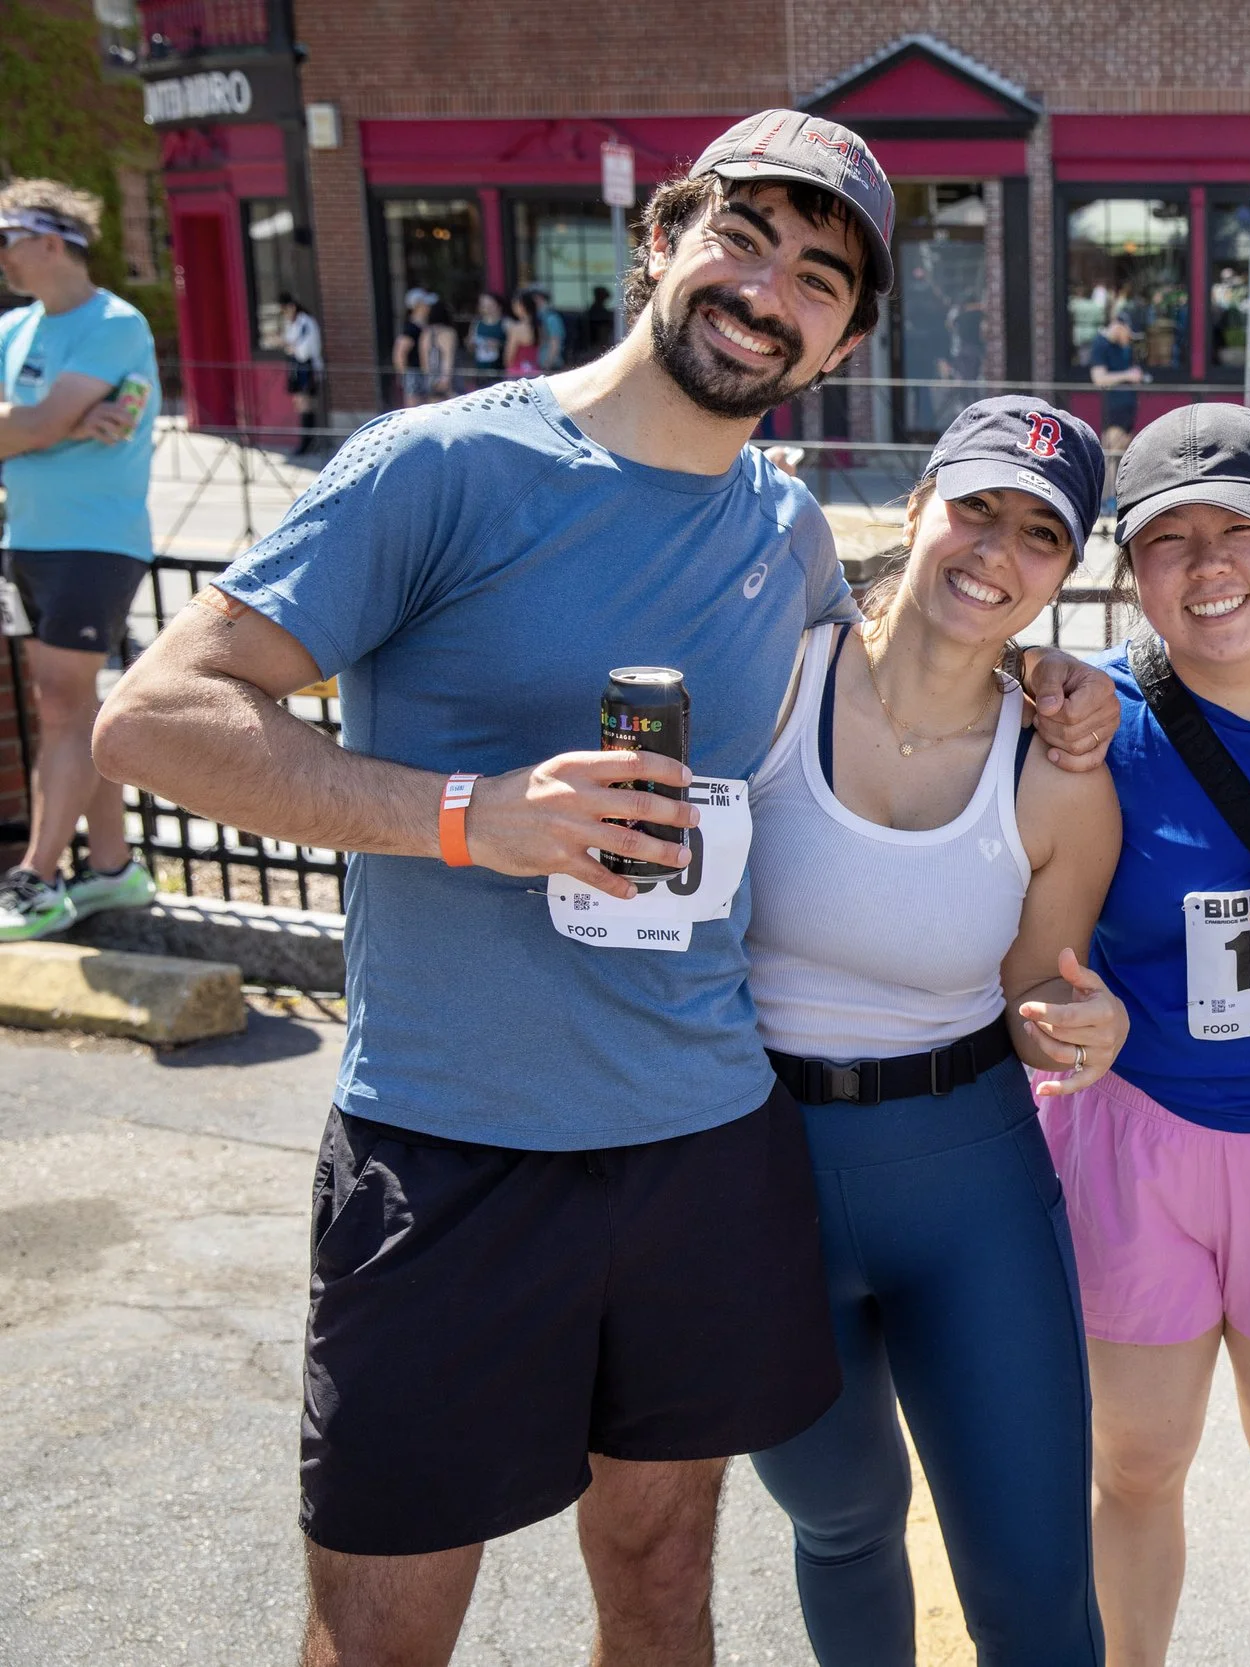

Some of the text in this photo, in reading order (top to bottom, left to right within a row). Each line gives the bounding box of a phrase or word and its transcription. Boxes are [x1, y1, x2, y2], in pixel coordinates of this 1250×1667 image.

[802, 130, 880, 191] MIT
[1017, 411, 1063, 458] B
[601, 708, 662, 732] ite Lite
[710, 783, 730, 794] 5K&
[567, 924, 681, 942] FOOD DRINK
[1203, 1023, 1239, 1034] FOOD
